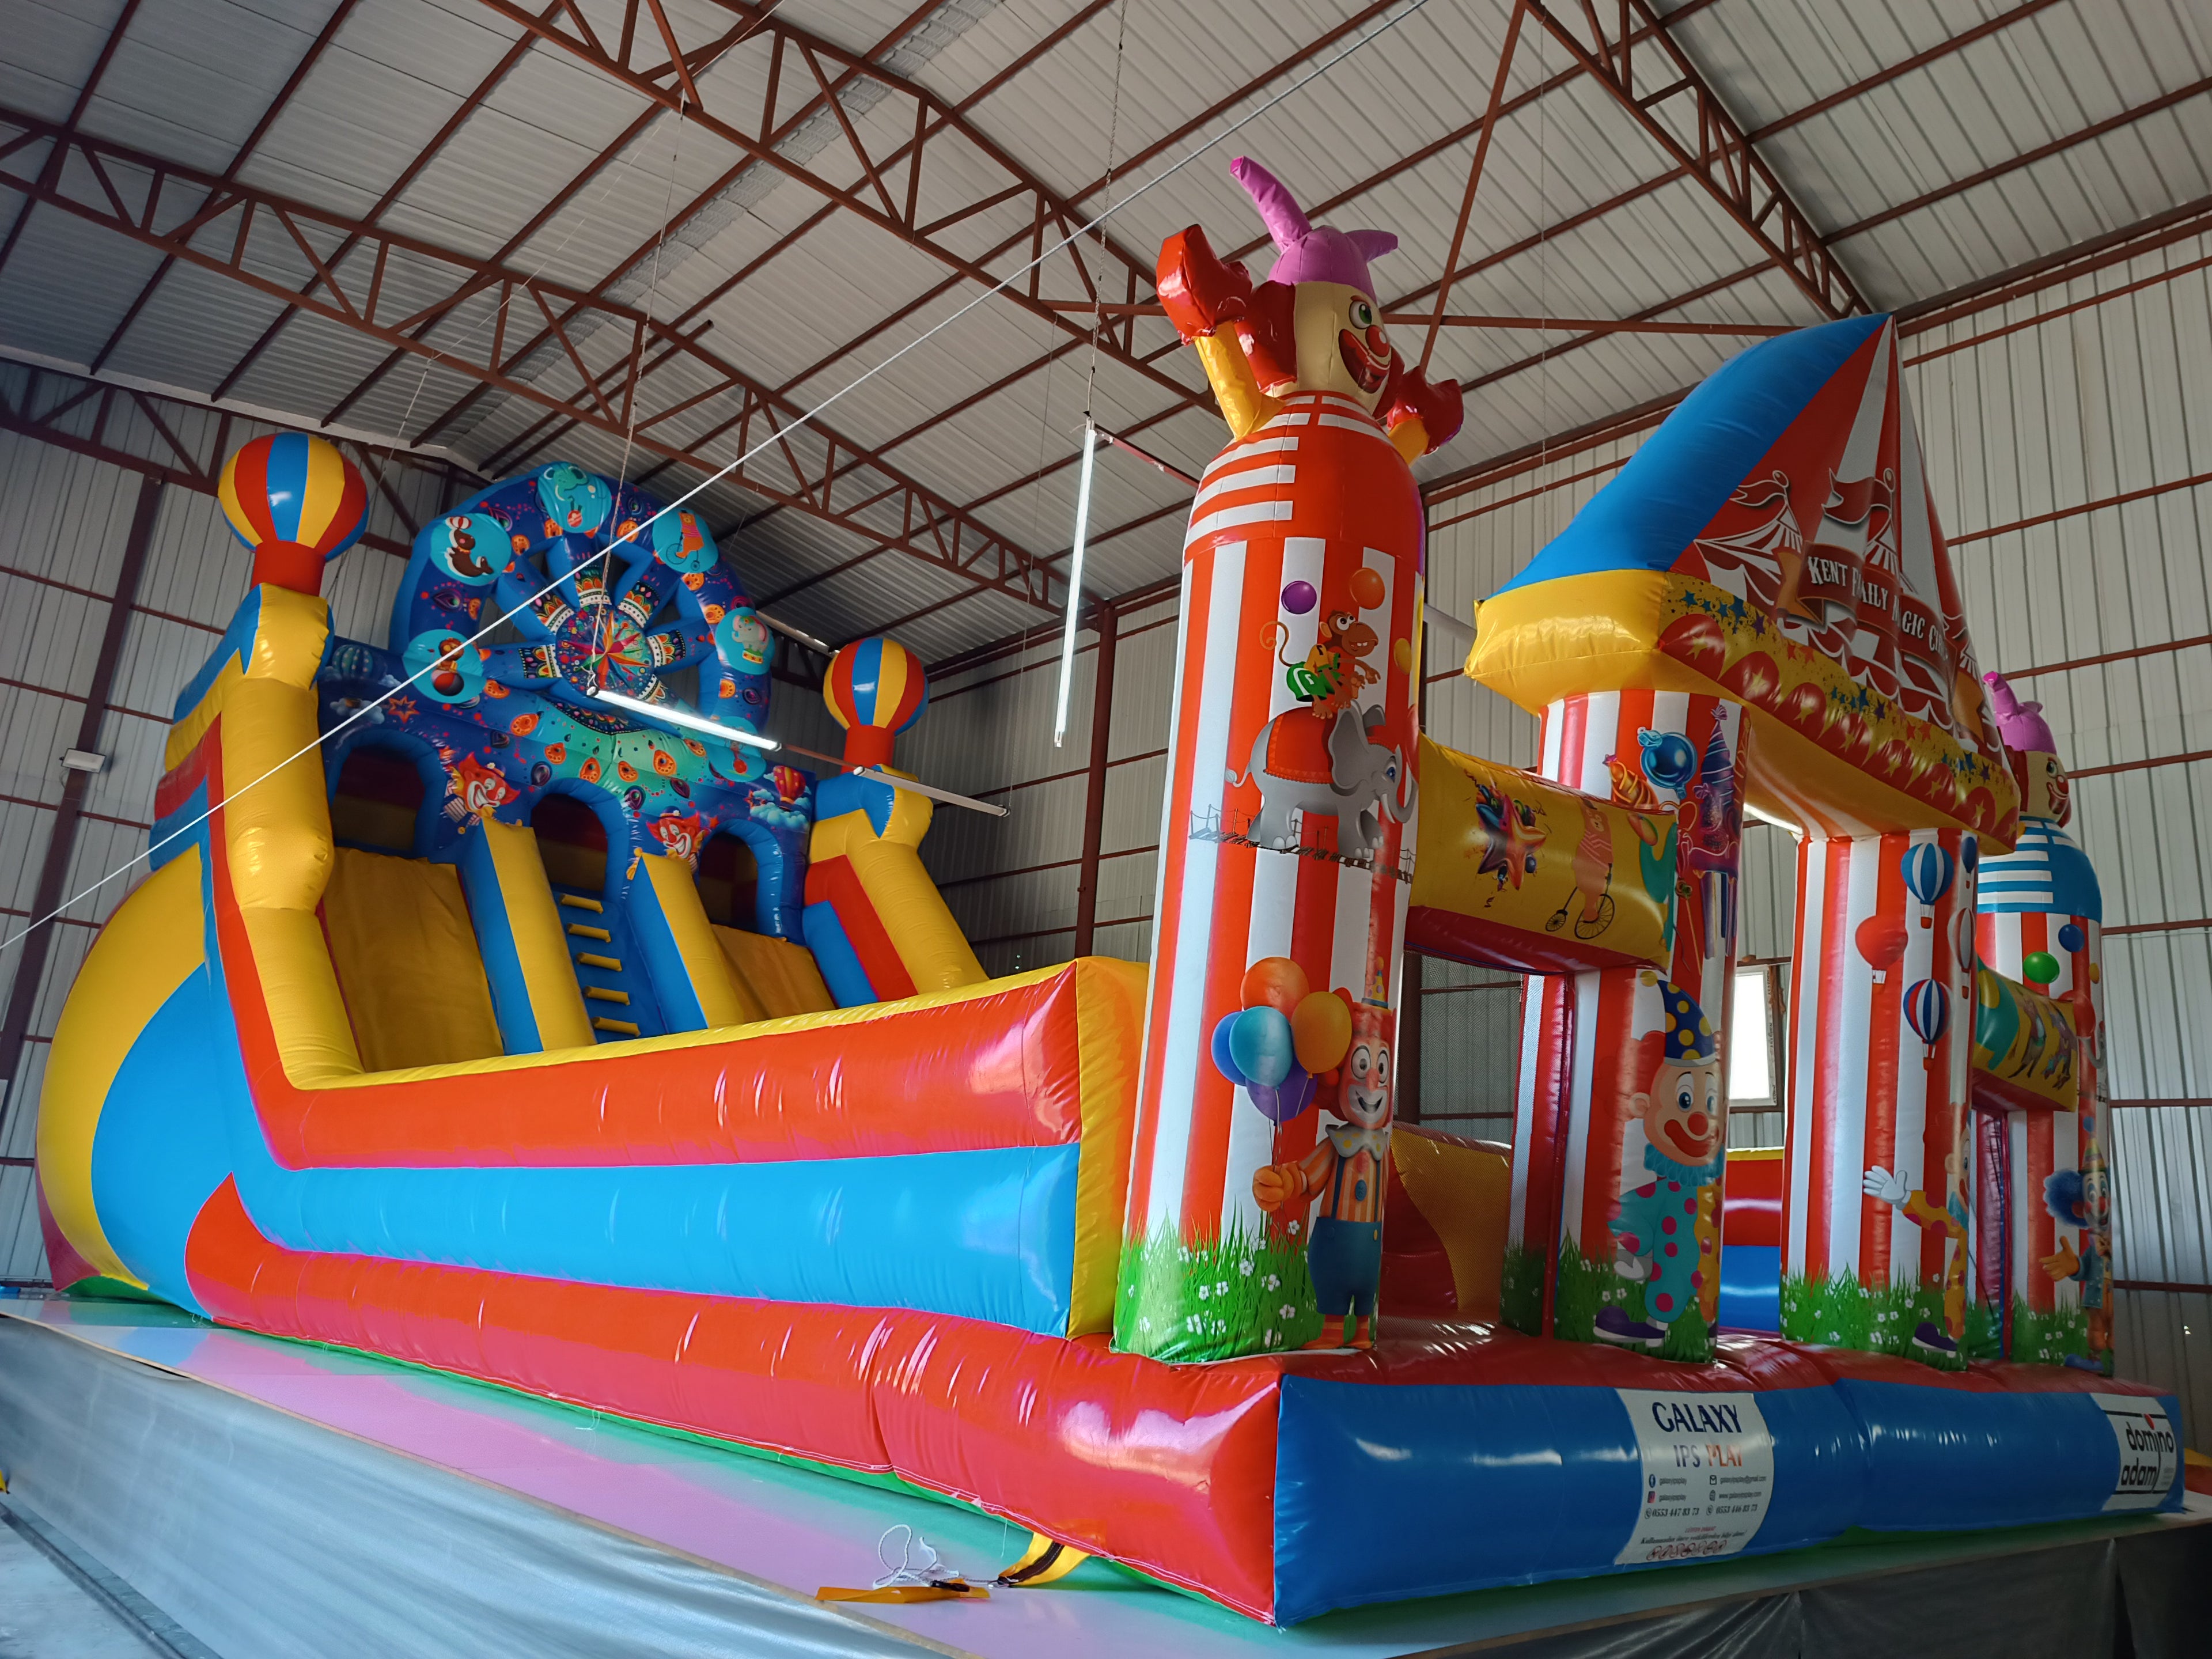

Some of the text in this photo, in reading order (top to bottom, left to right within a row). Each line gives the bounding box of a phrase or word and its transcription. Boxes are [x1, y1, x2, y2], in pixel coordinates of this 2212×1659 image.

[1808, 556, 1848, 586] KENT
[1851, 566, 1888, 611] FILY
[1891, 594, 1925, 639] MGIC
[1652, 1402, 1742, 1433] GALAXY
[2126, 1414, 2174, 1453] domino
[1673, 1444, 1700, 1468] IPS
[2120, 1457, 2157, 1486] adam
